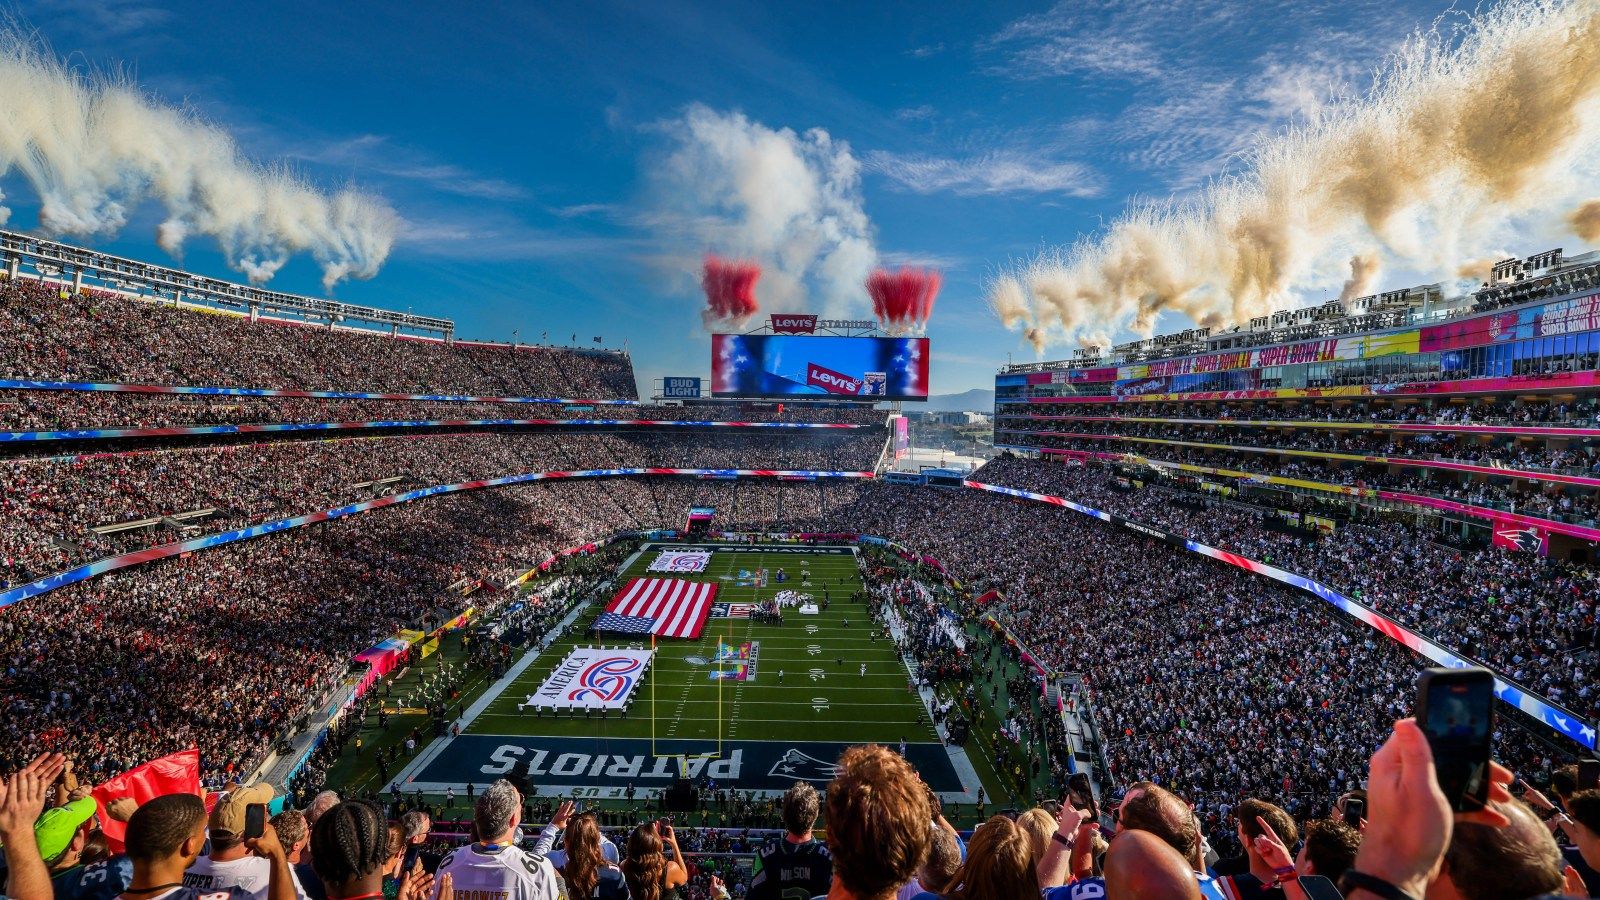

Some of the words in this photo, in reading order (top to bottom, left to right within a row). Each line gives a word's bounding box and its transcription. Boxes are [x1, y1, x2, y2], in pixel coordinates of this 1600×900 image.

[820, 319, 873, 329] STADIUM
[1540, 322, 1566, 336] SUPER
[1567, 318, 1590, 332] BOWL
[1258, 345, 1289, 367] SUPER
[1290, 341, 1321, 364] BOWL
[1321, 339, 1338, 361] LX
[1194, 355, 1218, 372] SUPER
[1219, 353, 1239, 370] BOWL
[665, 387, 698, 396] LIGHT
[670, 379, 694, 388] BUD
[541, 657, 589, 699] AMERICA
[480, 744, 743, 780] PATRIOTS
[570, 788, 599, 797] US
[520, 851, 545, 875] 60
[182, 871, 214, 889] UPER
[780, 867, 811, 881] WILSON
